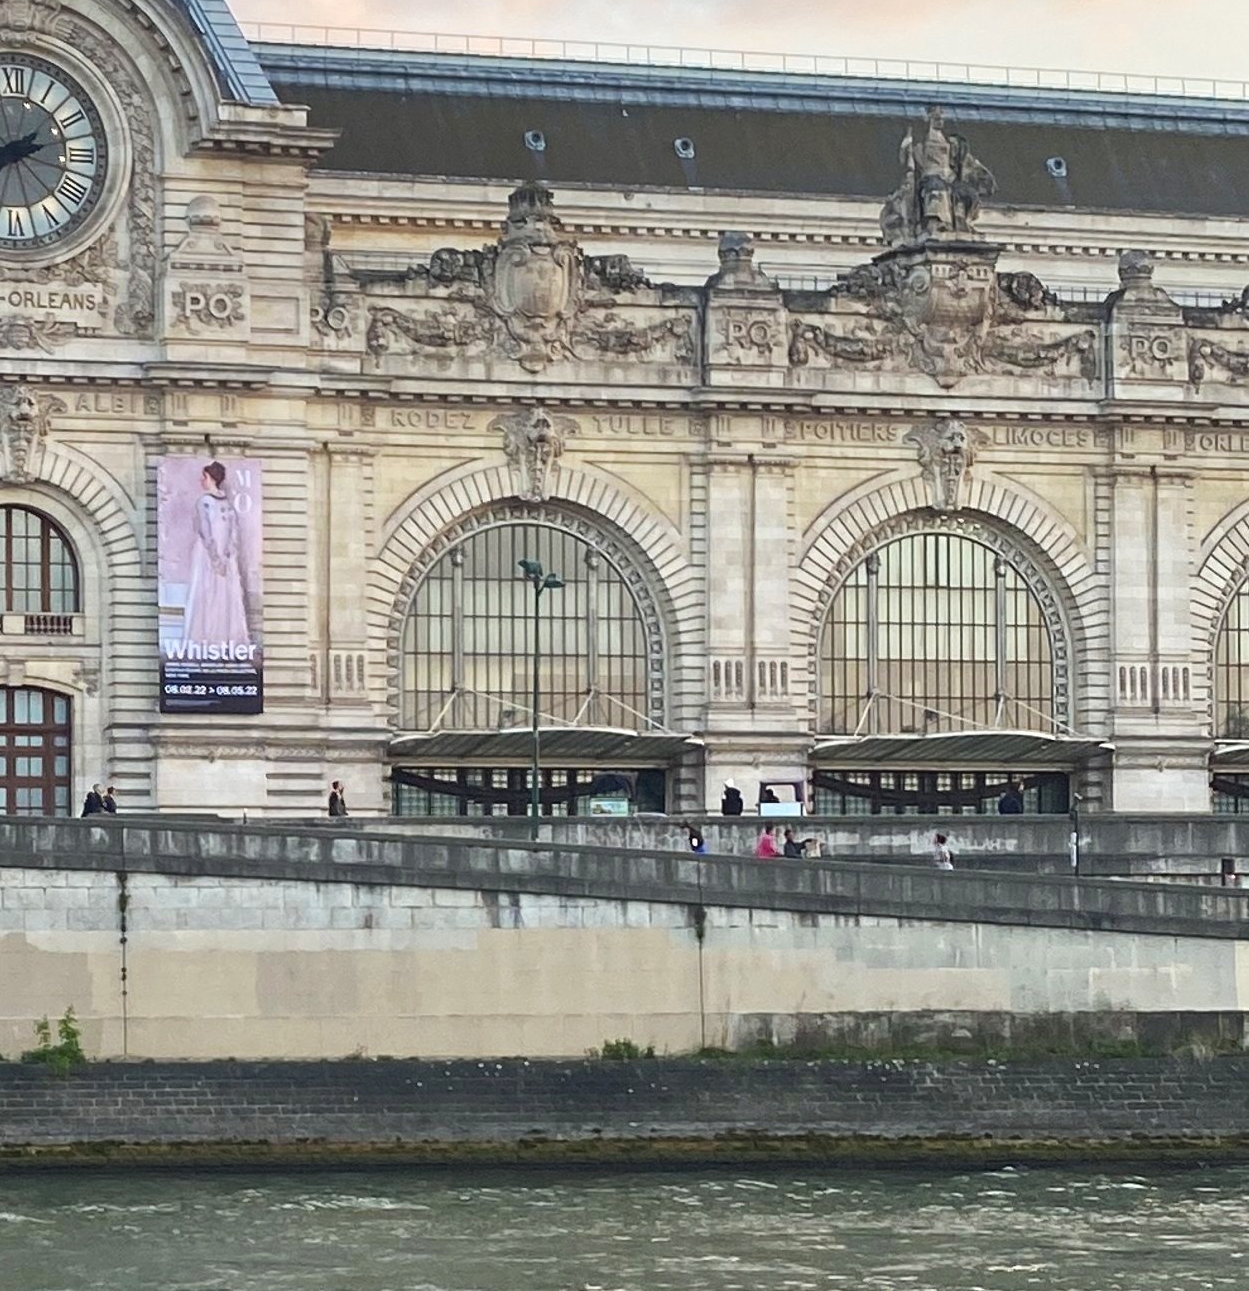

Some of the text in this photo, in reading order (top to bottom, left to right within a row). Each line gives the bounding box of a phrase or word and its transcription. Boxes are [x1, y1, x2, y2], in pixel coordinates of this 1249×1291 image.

[1, 67, 25, 95] XII
[40, 80, 56, 105] I
[59, 109, 86, 130] II
[69, 147, 95, 166] III
[56, 175, 88, 207] IIII
[6, 209, 25, 237] VI
[41, 204, 60, 227] V
[184, 291, 233, 320] PO
[729, 320, 771, 346] PO
[1130, 336, 1171, 360] PO
[75, 393, 137, 414] ALBI
[391, 409, 477, 430] RODEZ
[591, 415, 674, 435] TULLE
[799, 420, 897, 442] POITIERS
[163, 639, 258, 661] Whistler
